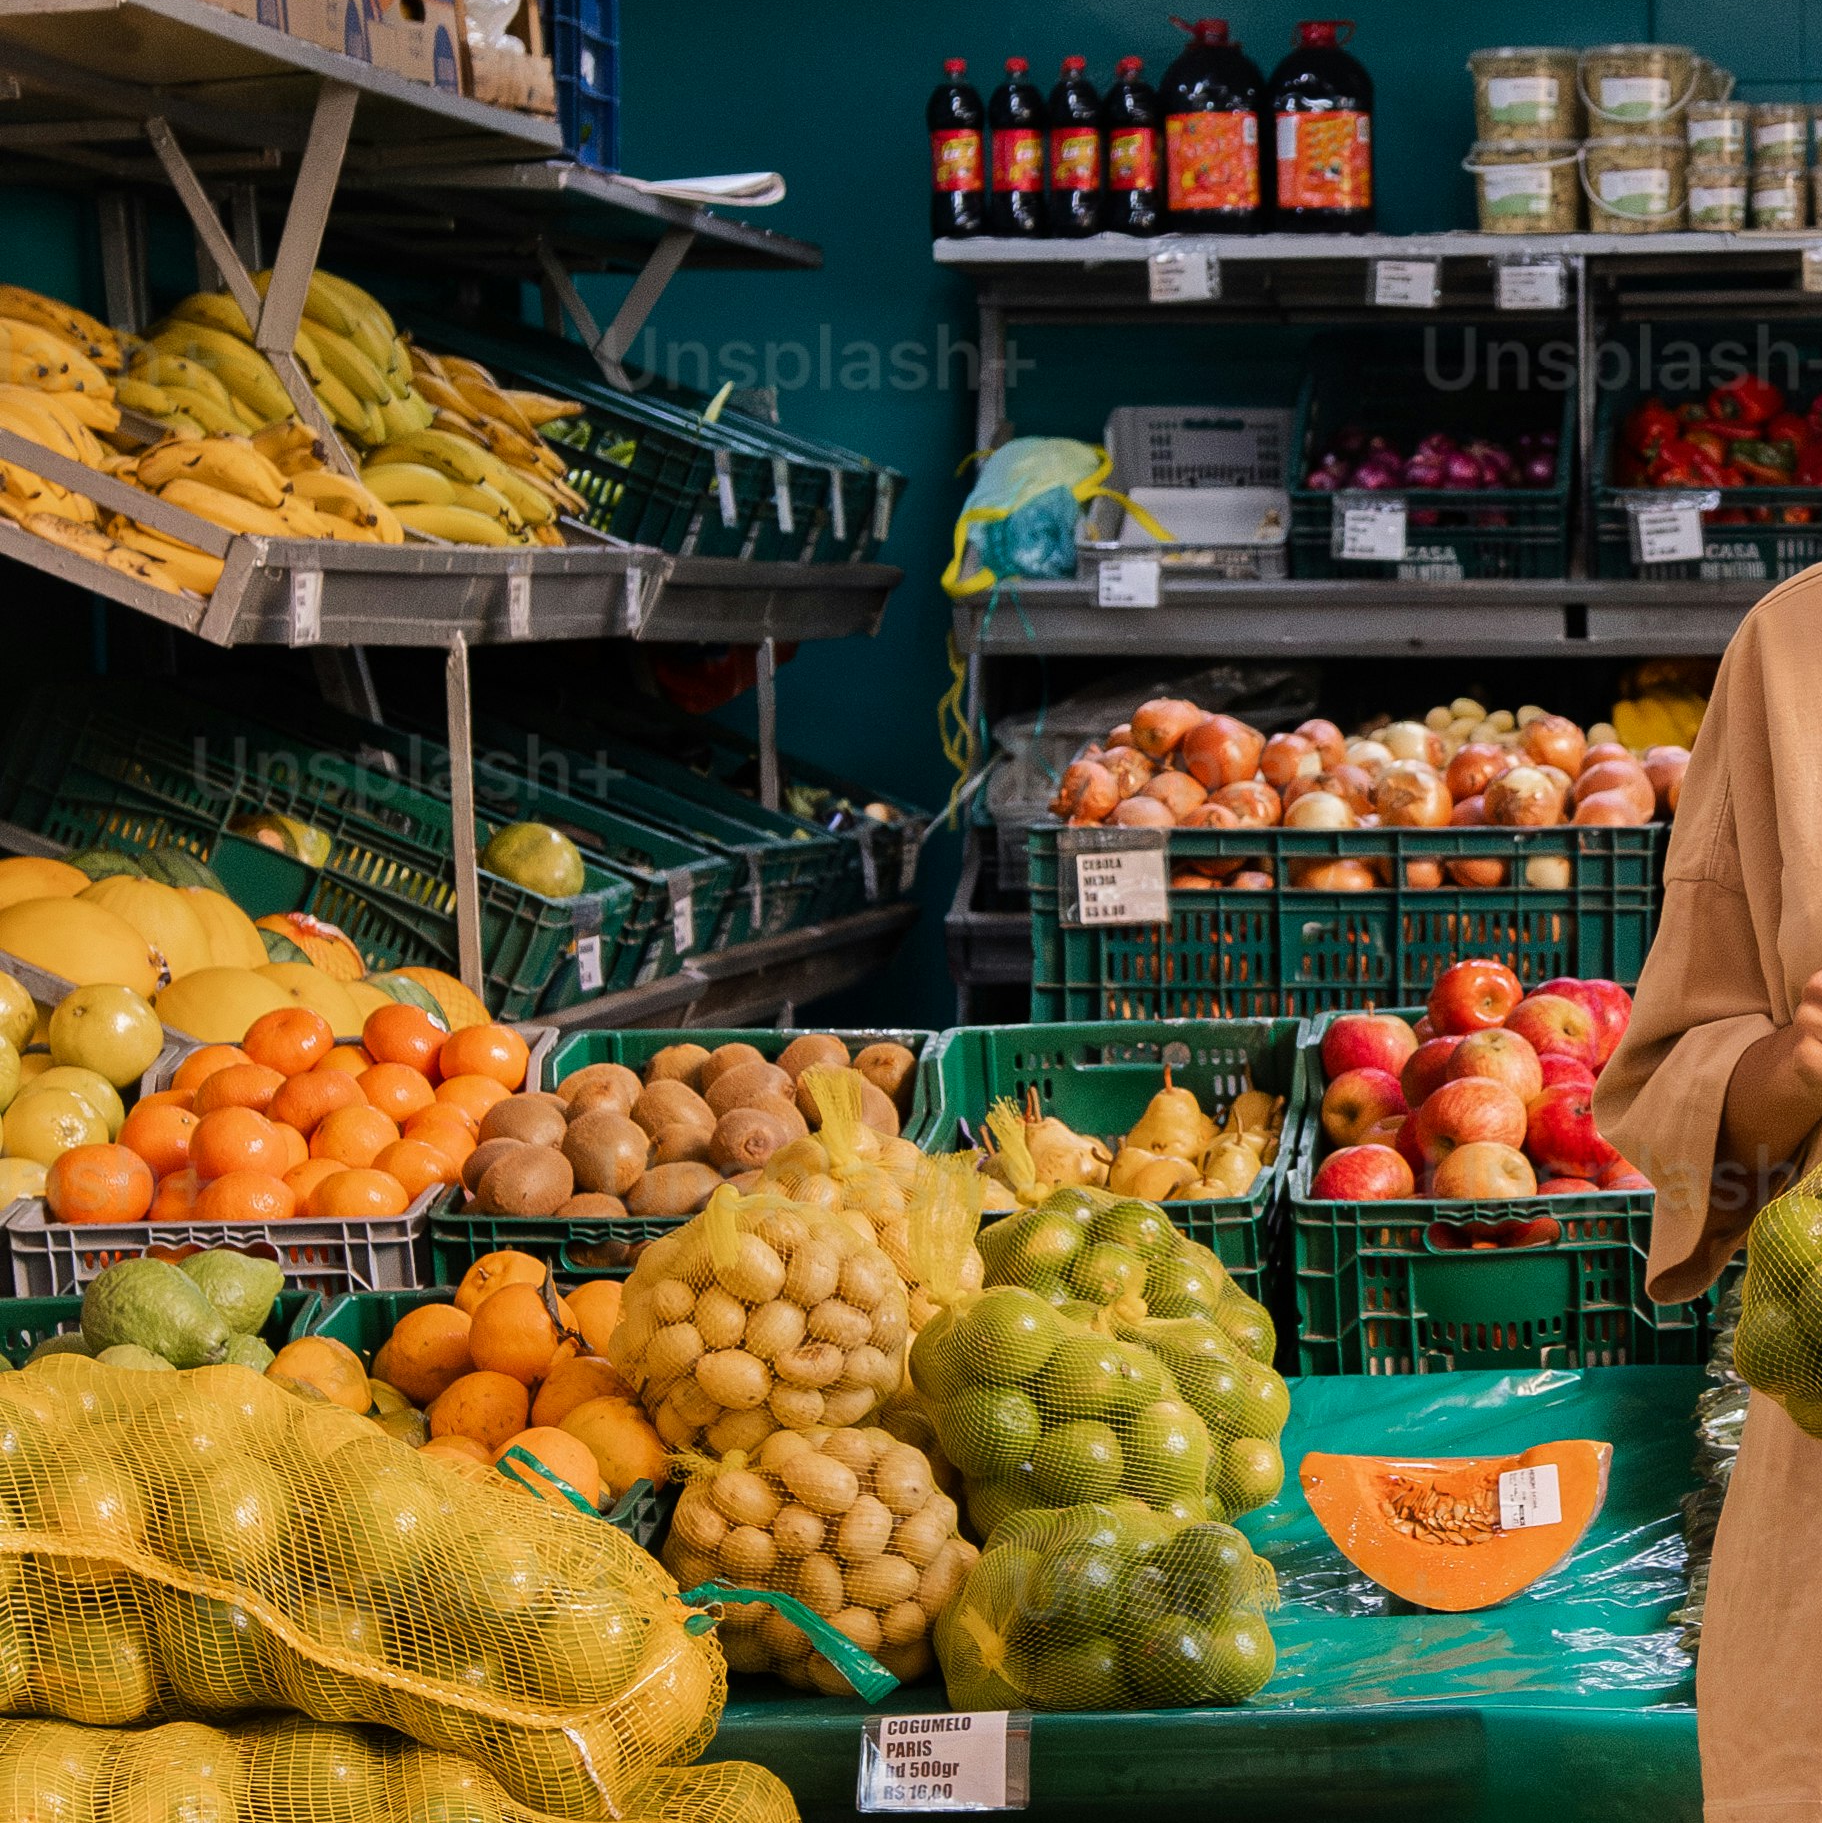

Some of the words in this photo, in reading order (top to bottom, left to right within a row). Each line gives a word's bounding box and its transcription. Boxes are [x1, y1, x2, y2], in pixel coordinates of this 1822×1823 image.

[887, 1717, 972, 1735] COGUMELO
[886, 1740, 932, 1758] PARIS
[909, 1761, 960, 1778] 500gr
[883, 1784, 905, 1800] R$
[908, 1783, 953, 1801] 16,00
